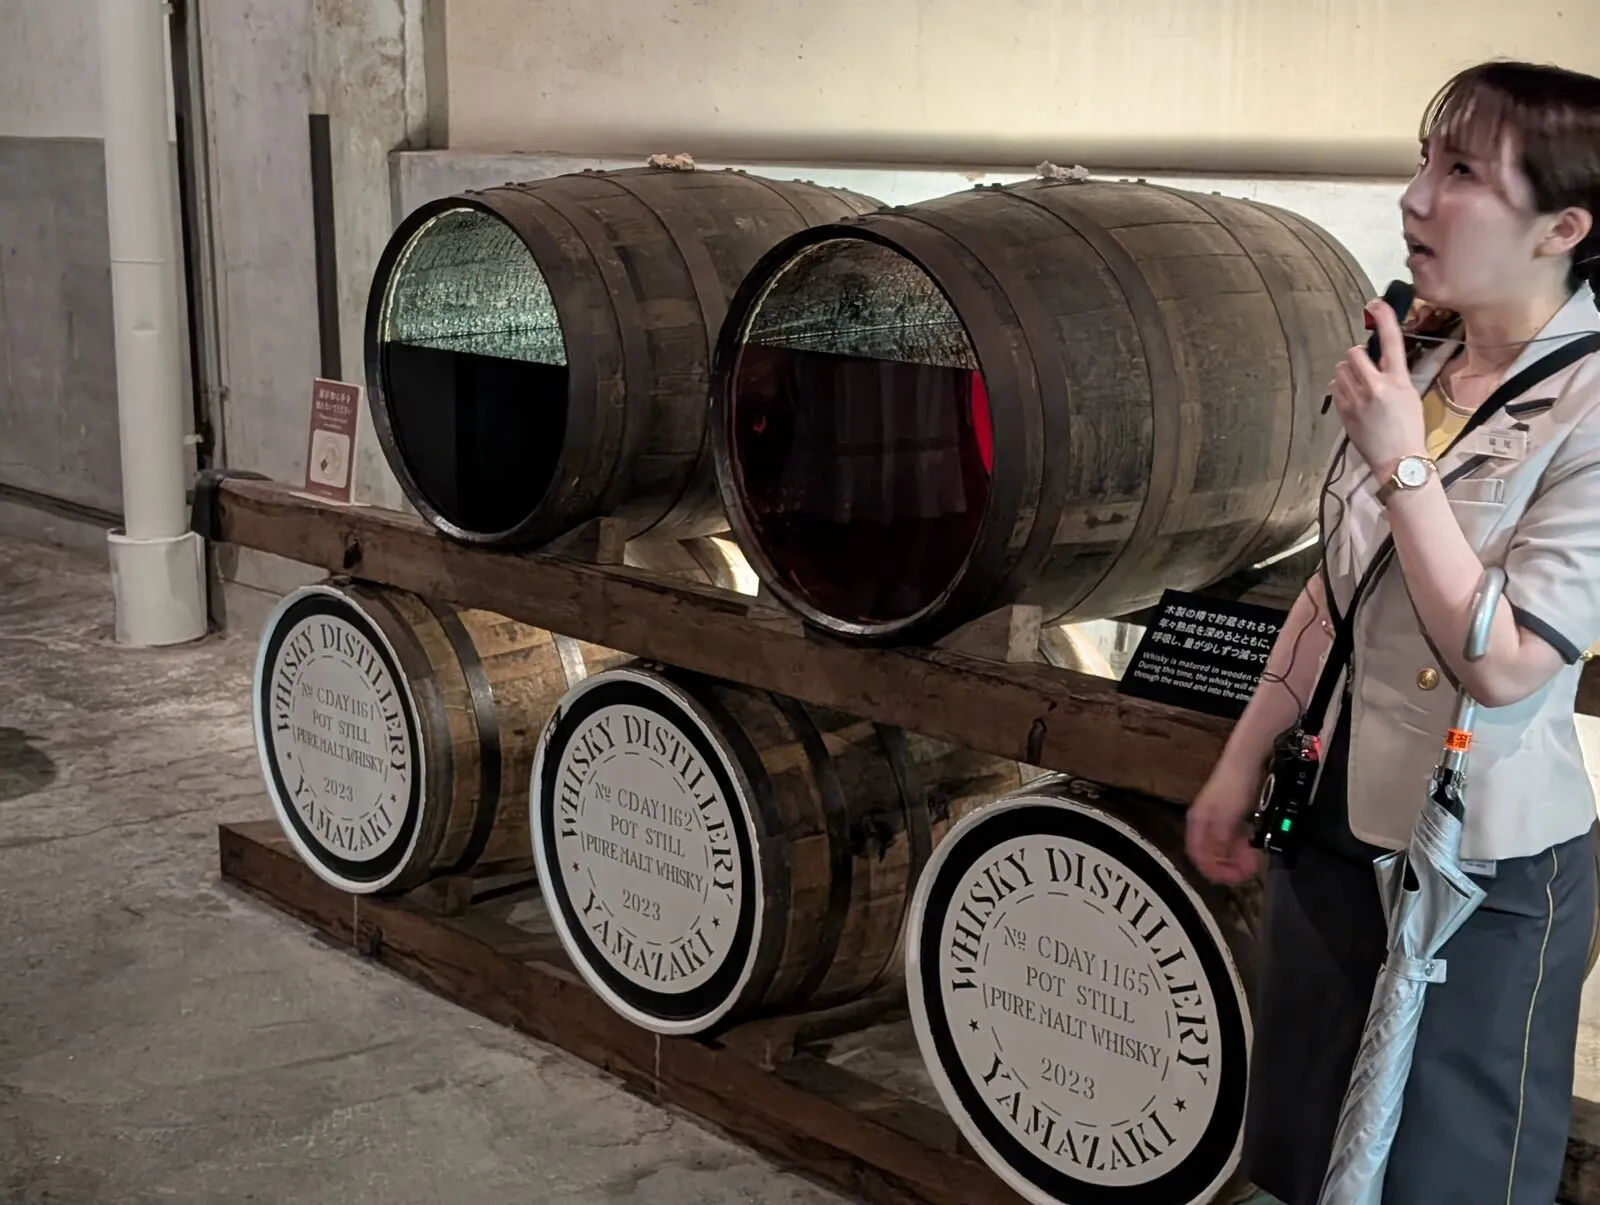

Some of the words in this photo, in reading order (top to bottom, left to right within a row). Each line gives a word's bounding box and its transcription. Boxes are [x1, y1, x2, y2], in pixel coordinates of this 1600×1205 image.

[1164, 605, 1280, 634] 木製の樽で貯蔵されるウ
[1134, 670, 1160, 683] through
[1160, 676, 1172, 685] the
[1173, 679, 1192, 689] wood
[1193, 684, 1207, 693] and
[1207, 685, 1222, 696] into
[1222, 689, 1235, 698] the
[1235, 692, 1252, 702] atm
[1138, 660, 1162, 673] During
[1162, 664, 1175, 675] this
[1195, 671, 1208, 681] the
[1208, 676, 1233, 689] whisky
[1233, 681, 1249, 691] will
[1143, 652, 1169, 665] Whisky
[1170, 656, 1177, 665] is
[1178, 659, 1211, 673] matured
[1212, 665, 1220, 674] in
[1221, 670, 1252, 681] wooden
[277, 625, 315, 732] WHISKY
[320, 623, 406, 783] DISTILLERY
[297, 727, 320, 749] PURE
[320, 738, 346, 760] MALT
[346, 746, 384, 774] WHISKY
[313, 709, 333, 731] POT
[339, 720, 371, 745] STILL
[323, 776, 354, 802] 2023
[561, 716, 616, 839] WHISKY
[623, 715, 734, 905] DISTILLERY
[295, 776, 393, 851] YAMAZAKI
[611, 814, 639, 839] POT
[645, 828, 685, 857] STILL
[586, 834, 618, 861] PURE
[620, 846, 653, 873] MALT
[656, 859, 703, 893] WHISKY
[622, 888, 661, 921] 2023
[582, 891, 714, 982] YAMAZAKI
[951, 847, 1034, 992] WHISKY
[1044, 847, 1210, 1086] DISTILLERY
[1026, 965, 1066, 998] POT
[1076, 985, 1135, 1024] STILL
[990, 986, 1036, 1022] PURE
[1039, 1004, 1087, 1040] MALT
[1091, 1024, 1162, 1068] WHISKY
[1041, 1056, 1095, 1100] 2023
[981, 1052, 1177, 1171] YAMAZAKI
